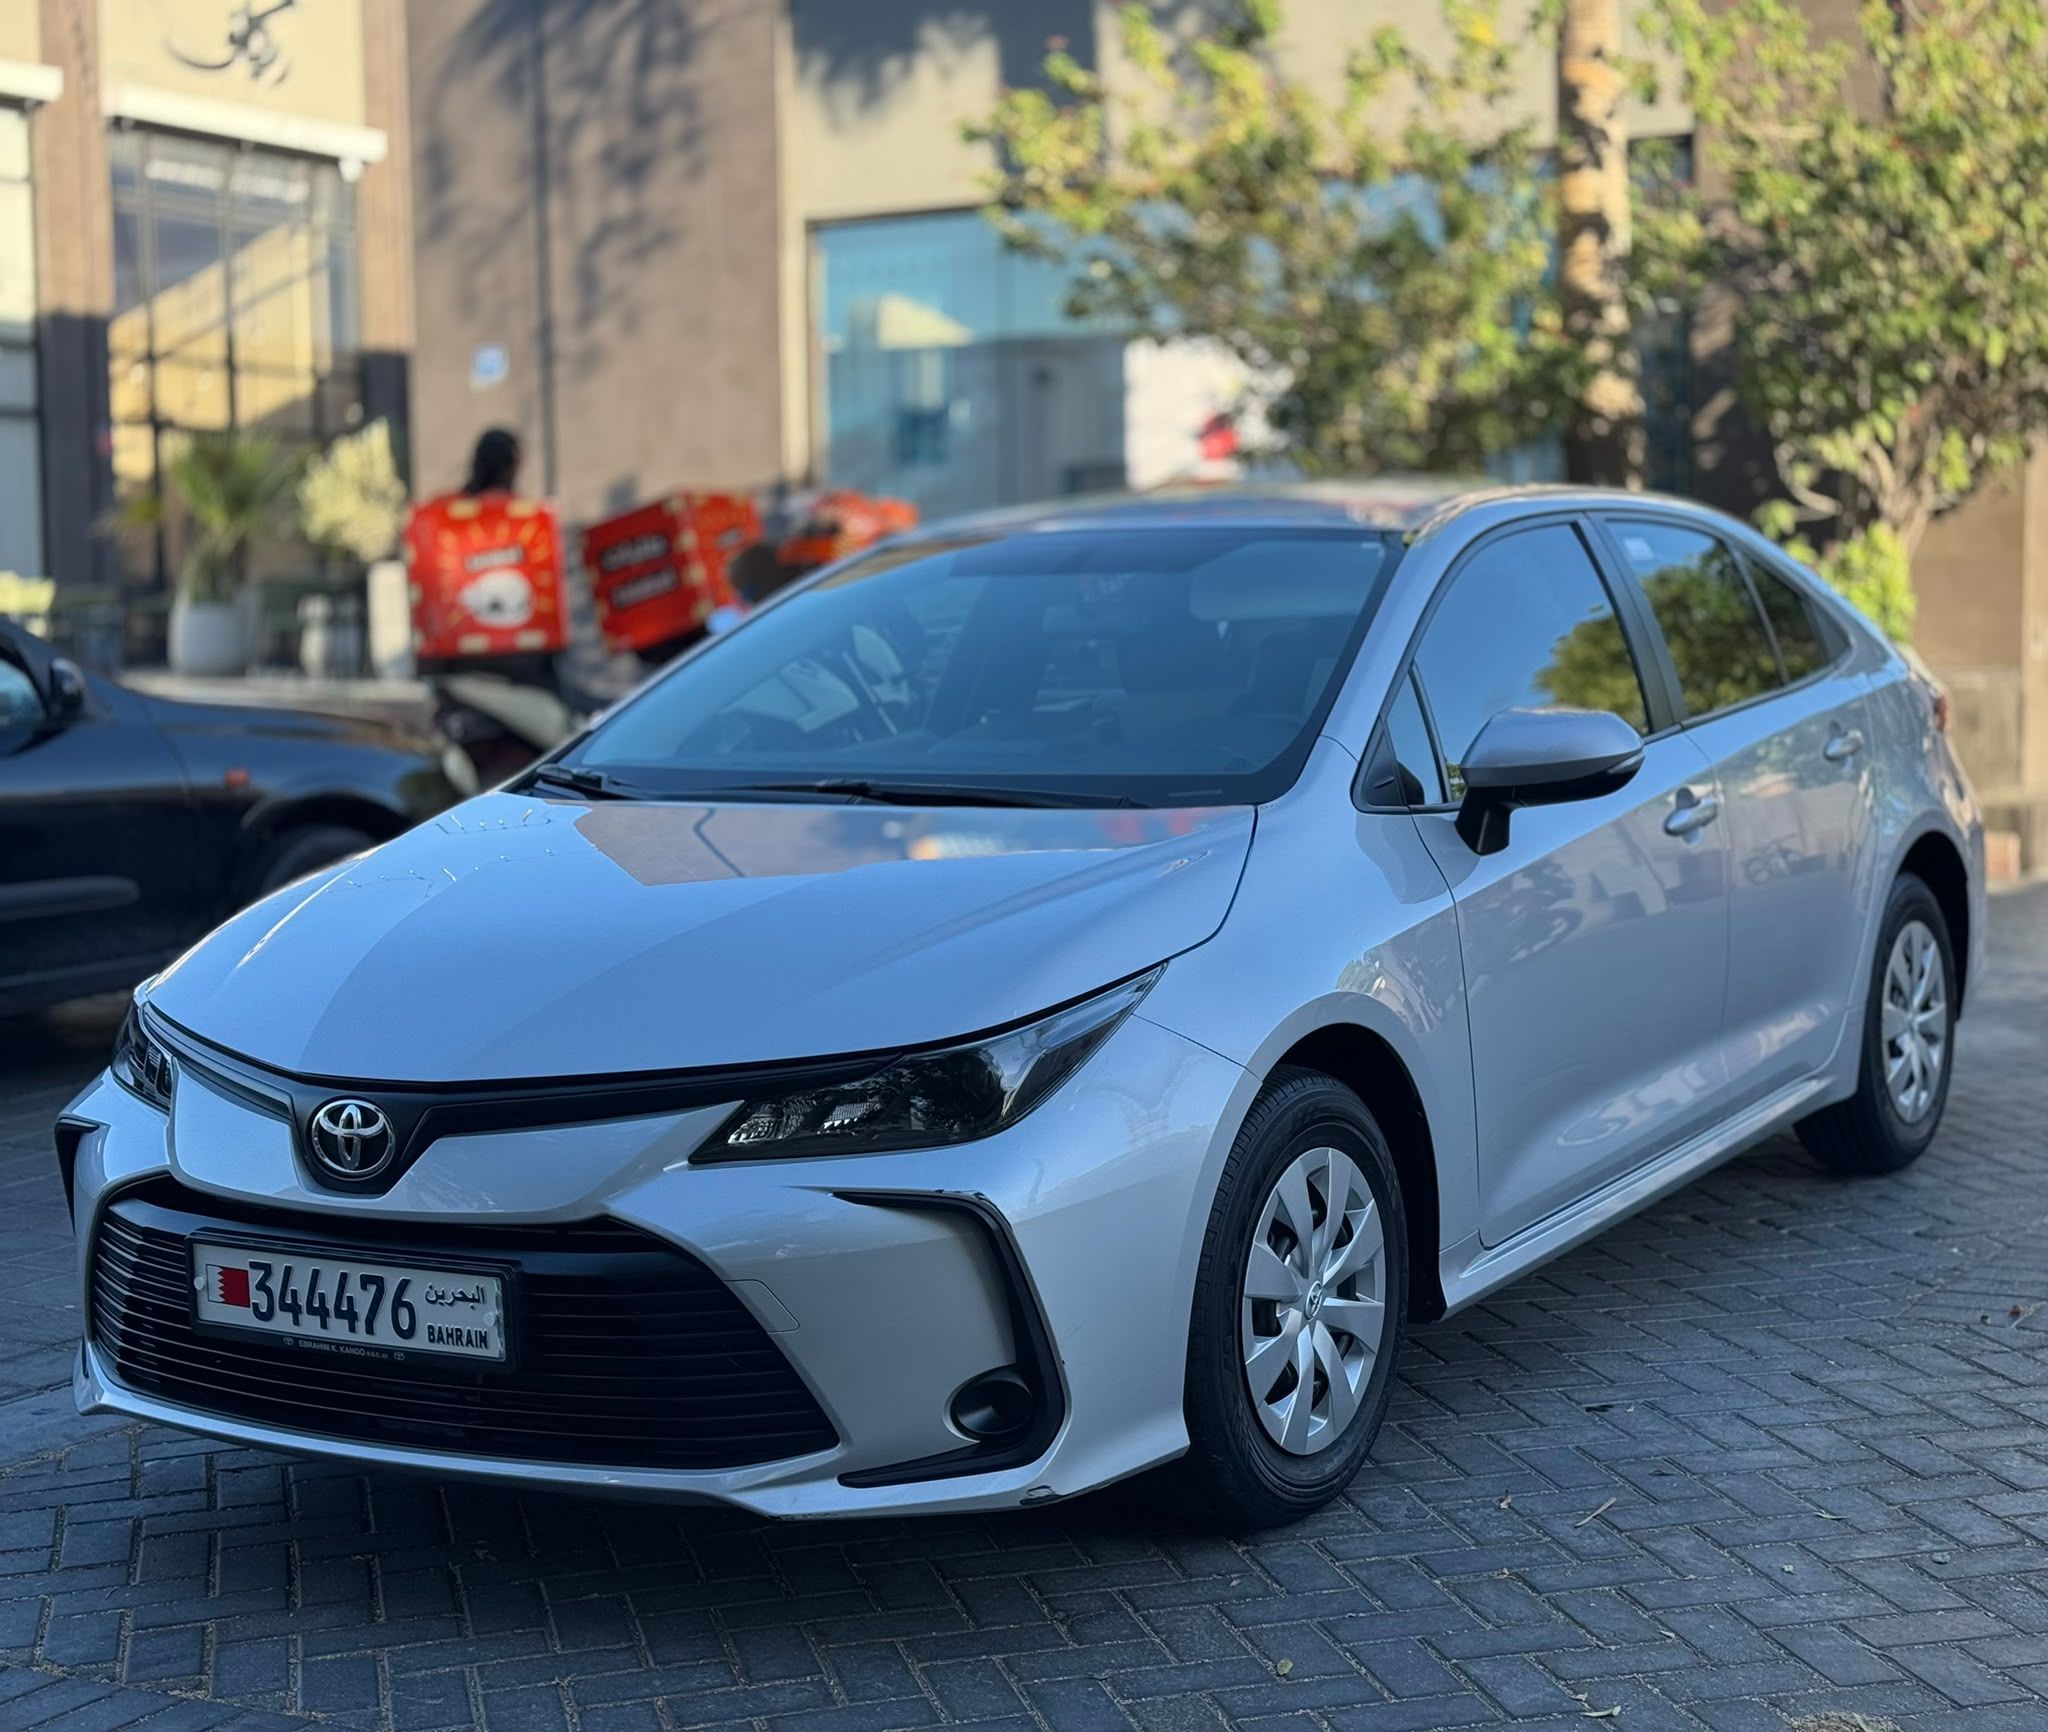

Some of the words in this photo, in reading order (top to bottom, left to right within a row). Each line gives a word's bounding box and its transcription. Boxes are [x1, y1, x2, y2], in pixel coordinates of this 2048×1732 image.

[249, 1260, 416, 1340] 344476
[425, 1282, 485, 1310] البحرين
[426, 1323, 488, 1349] BAHRAIN
